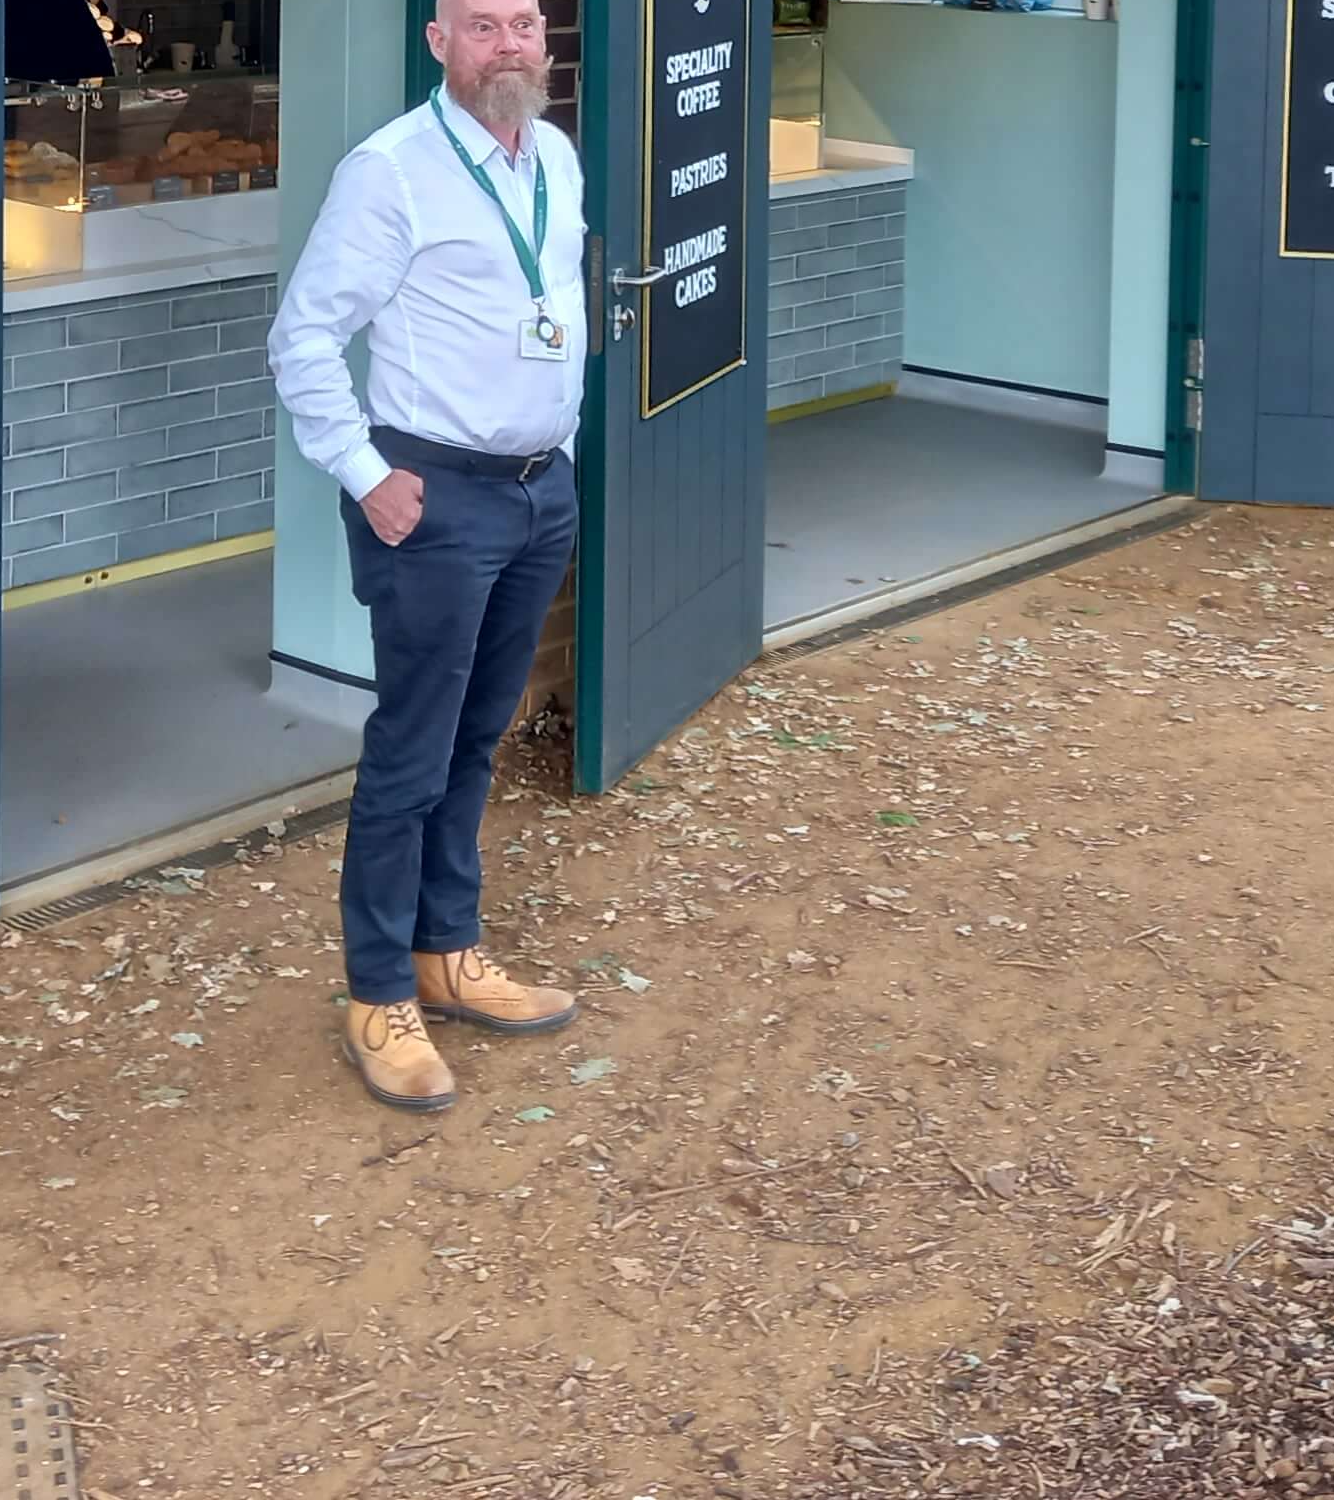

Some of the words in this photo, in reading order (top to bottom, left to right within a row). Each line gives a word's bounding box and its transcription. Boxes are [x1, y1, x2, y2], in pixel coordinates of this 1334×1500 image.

[666, 41, 733, 85] SPECIALITY
[677, 80, 721, 118] COFFEE
[670, 153, 728, 197] PASTRIES
[664, 226, 728, 275] HANDMADE
[675, 266, 717, 307] CAKES
